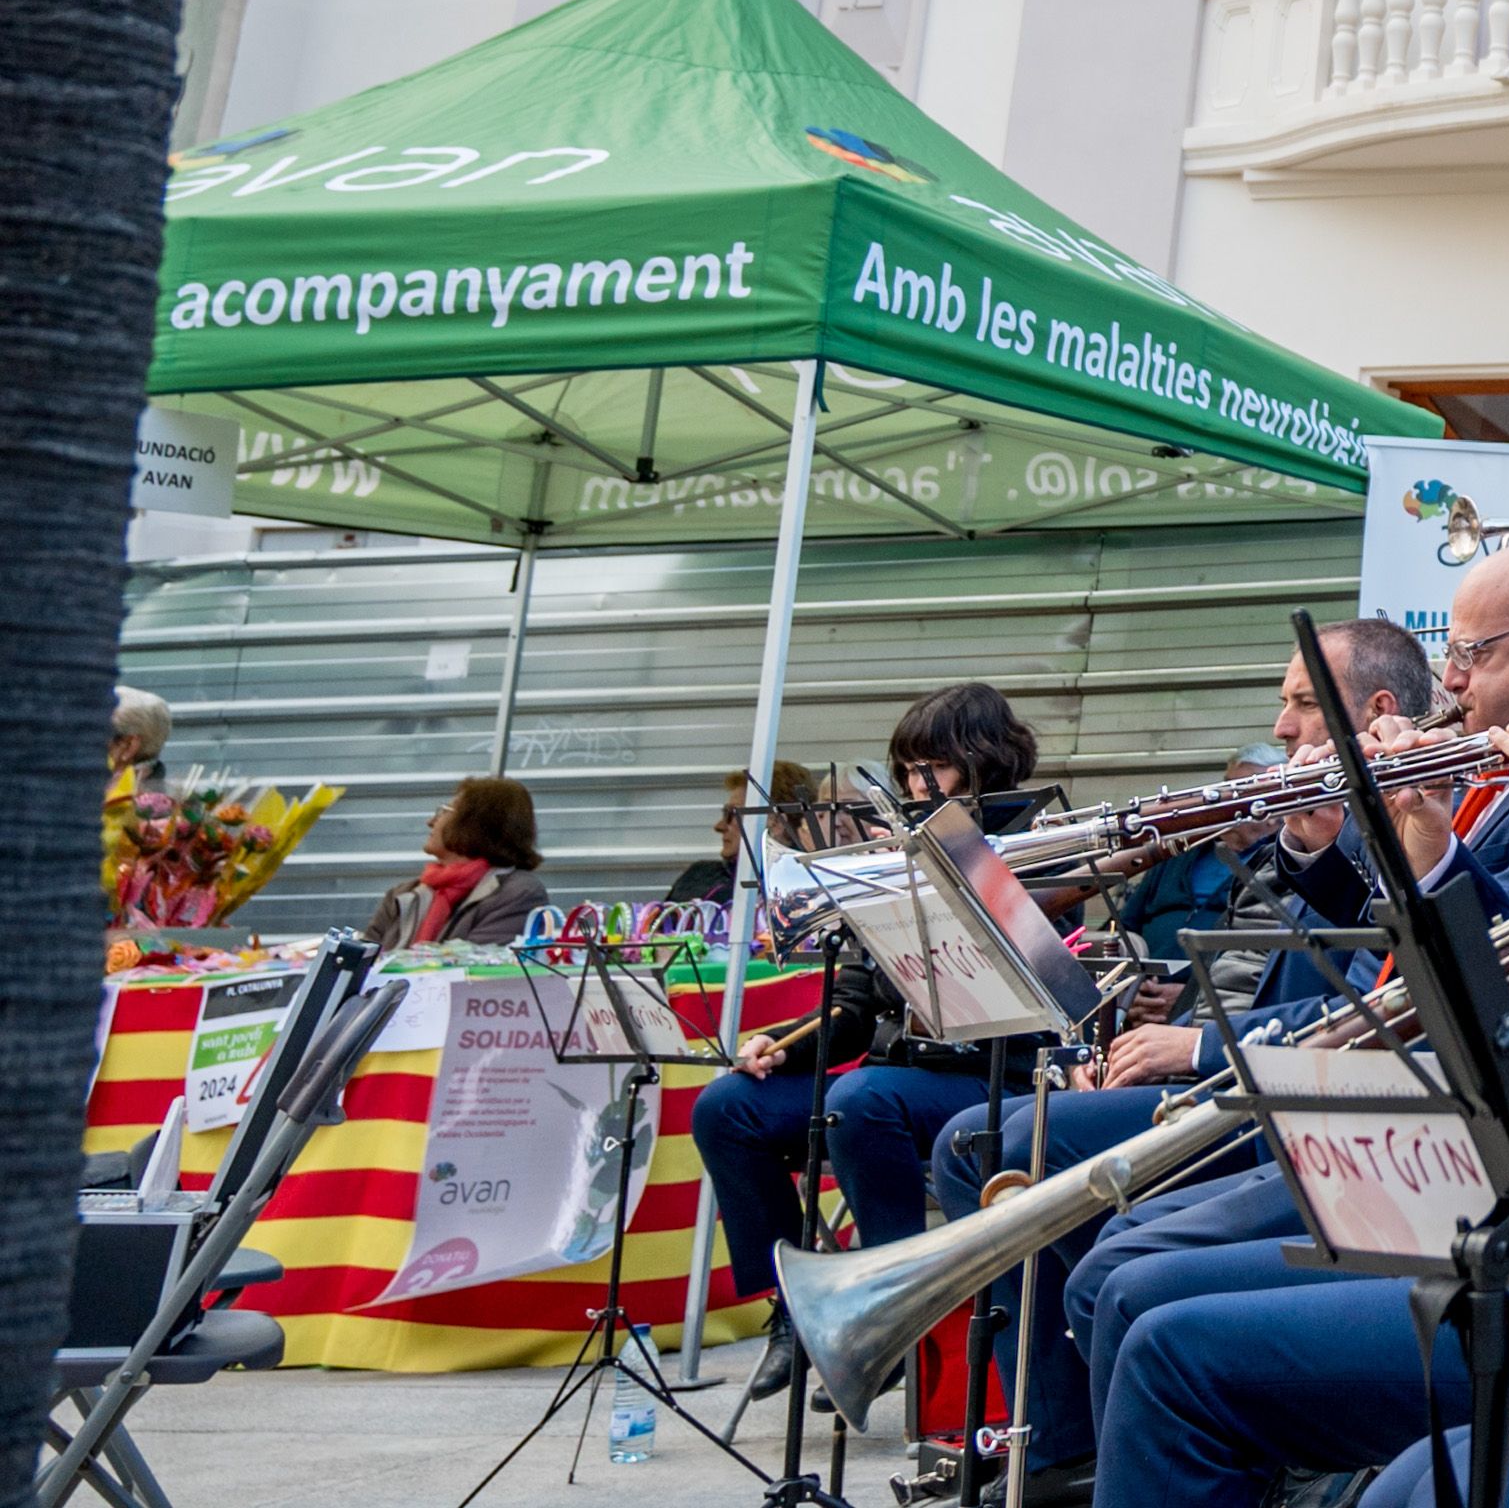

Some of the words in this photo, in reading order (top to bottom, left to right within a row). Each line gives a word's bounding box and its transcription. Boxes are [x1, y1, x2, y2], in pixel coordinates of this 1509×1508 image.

[169, 241, 755, 335] acompanyament
[853, 241, 966, 333] Amb
[976, 276, 1038, 356] les
[1046, 319, 1213, 410] malalties
[137, 440, 216, 465] UNDACIÓ
[142, 470, 194, 490] AVAN
[465, 998, 531, 1018] ROSA
[457, 1029, 582, 1050] SOLIDARA
[199, 1074, 238, 1102] 2024
[439, 1178, 512, 1206] avan
